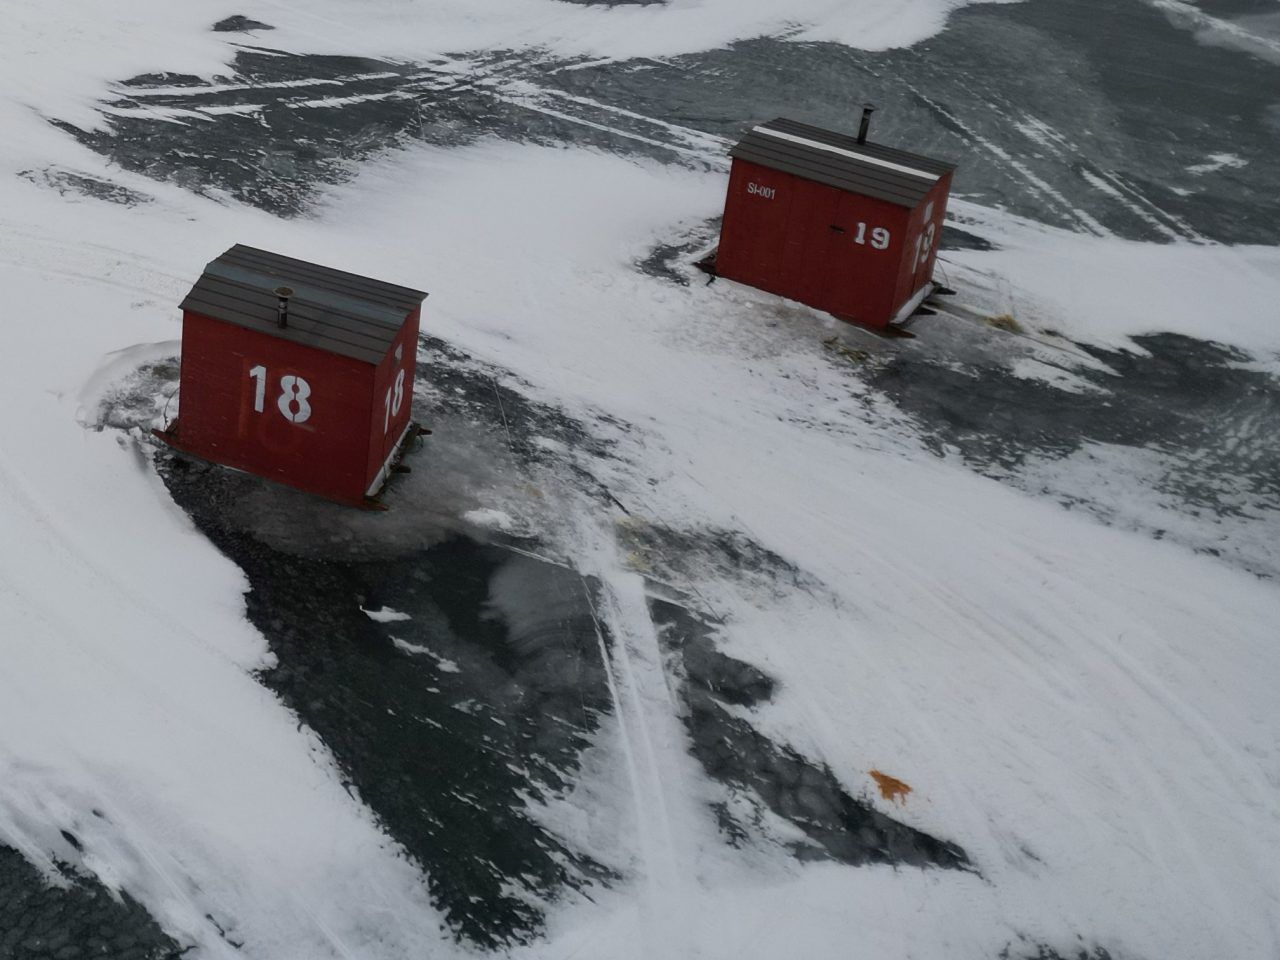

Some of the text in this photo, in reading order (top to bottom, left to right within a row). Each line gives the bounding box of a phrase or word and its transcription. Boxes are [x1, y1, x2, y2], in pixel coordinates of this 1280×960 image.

[747, 182, 776, 200] SI-001
[854, 222, 890, 250] 19
[912, 223, 935, 274] 19
[249, 365, 312, 423] 18
[384, 368, 405, 434] 18
